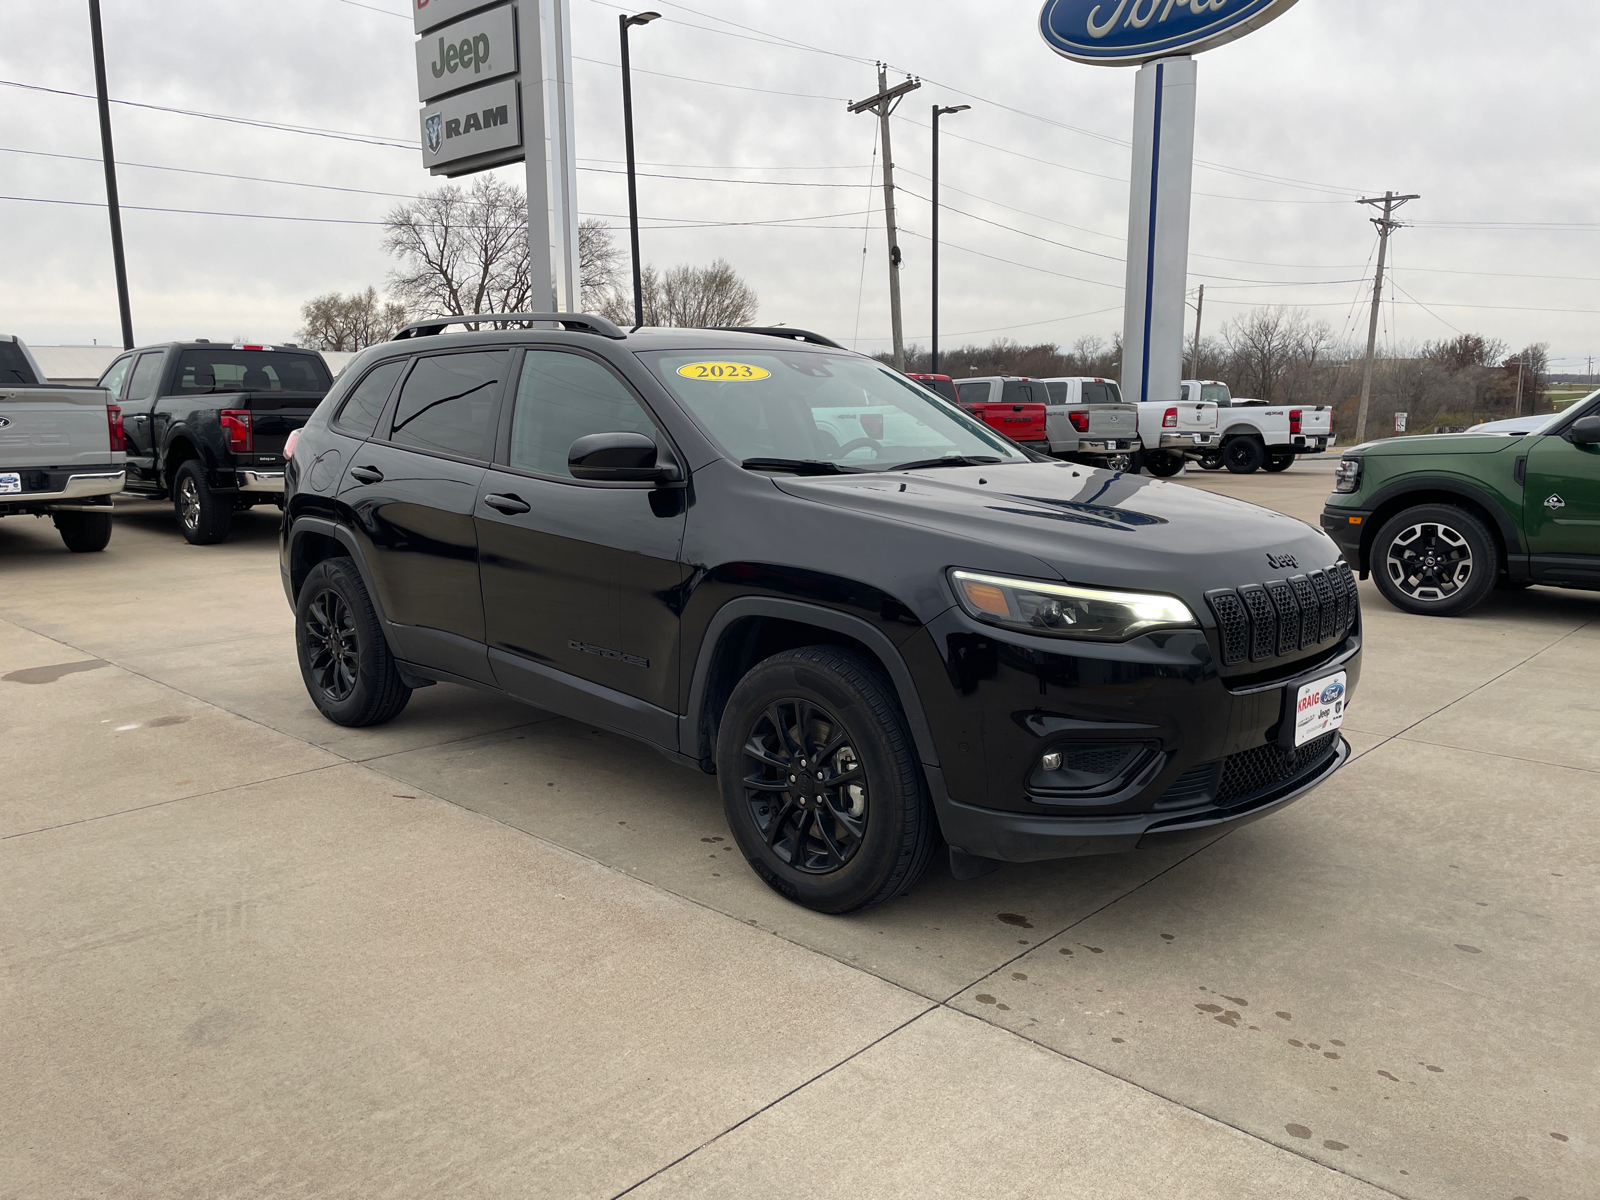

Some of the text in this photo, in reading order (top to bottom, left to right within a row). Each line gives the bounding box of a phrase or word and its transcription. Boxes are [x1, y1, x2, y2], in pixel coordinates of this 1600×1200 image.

[431, 32, 490, 79] Jeep
[445, 104, 509, 140] RAM
[694, 365, 753, 378] 2023
[1266, 553, 1299, 569] Jeep
[567, 639, 650, 669] CHEROKEE
[1297, 687, 1340, 713] KRAIG Ford
[1318, 708, 1331, 720] Jeep
